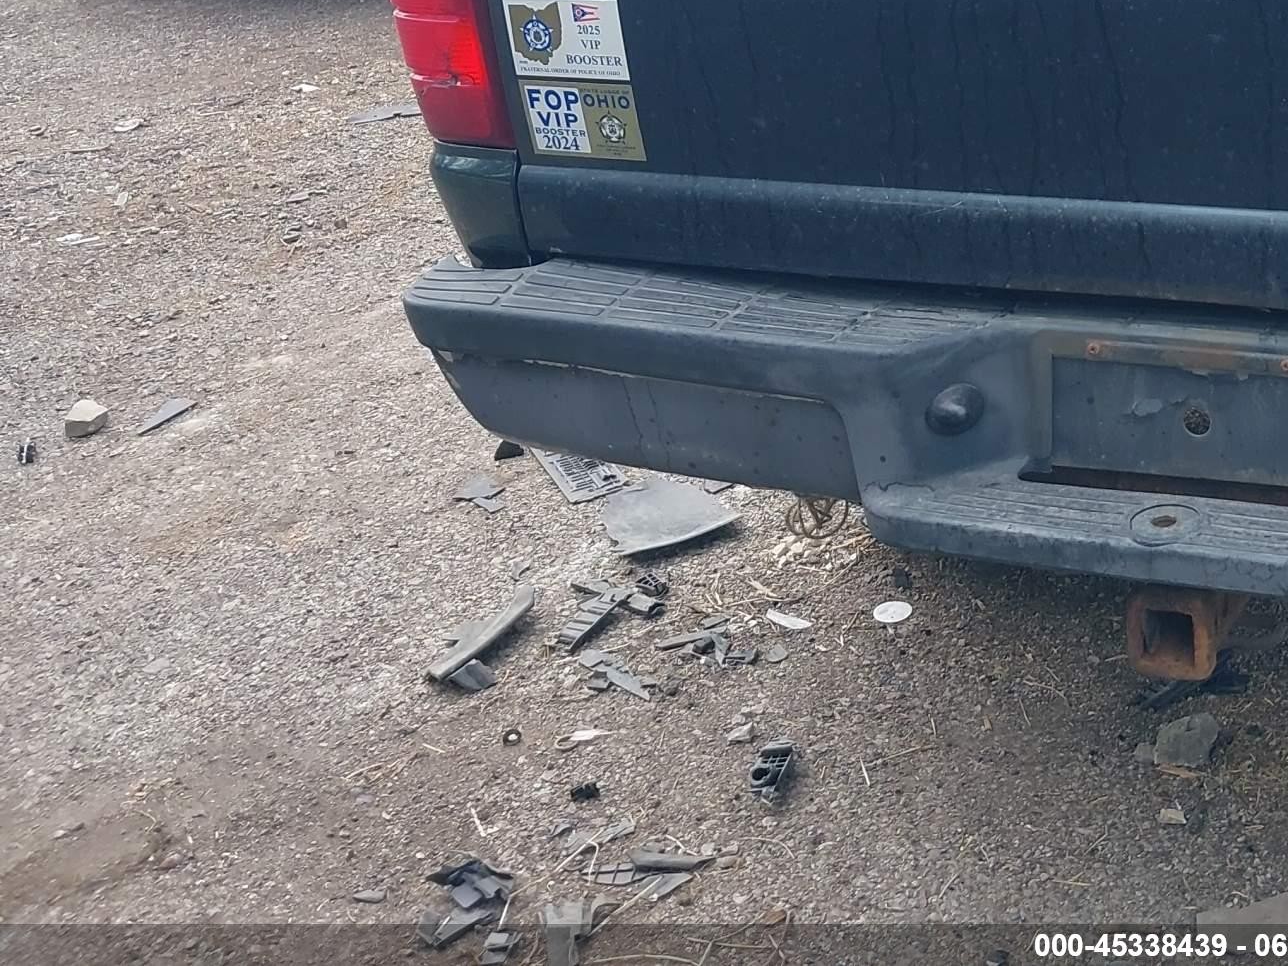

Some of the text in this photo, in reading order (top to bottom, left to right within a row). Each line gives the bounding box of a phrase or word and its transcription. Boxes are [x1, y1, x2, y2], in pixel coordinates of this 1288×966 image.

[576, 24, 601, 35] 2025
[580, 39, 601, 50] VIP
[566, 54, 622, 67] BOOSTER
[527, 88, 579, 112] FOP
[583, 94, 630, 109] OHIO
[535, 111, 578, 128] VIP
[535, 127, 586, 138] BOOSTER
[542, 135, 580, 151] 2024
